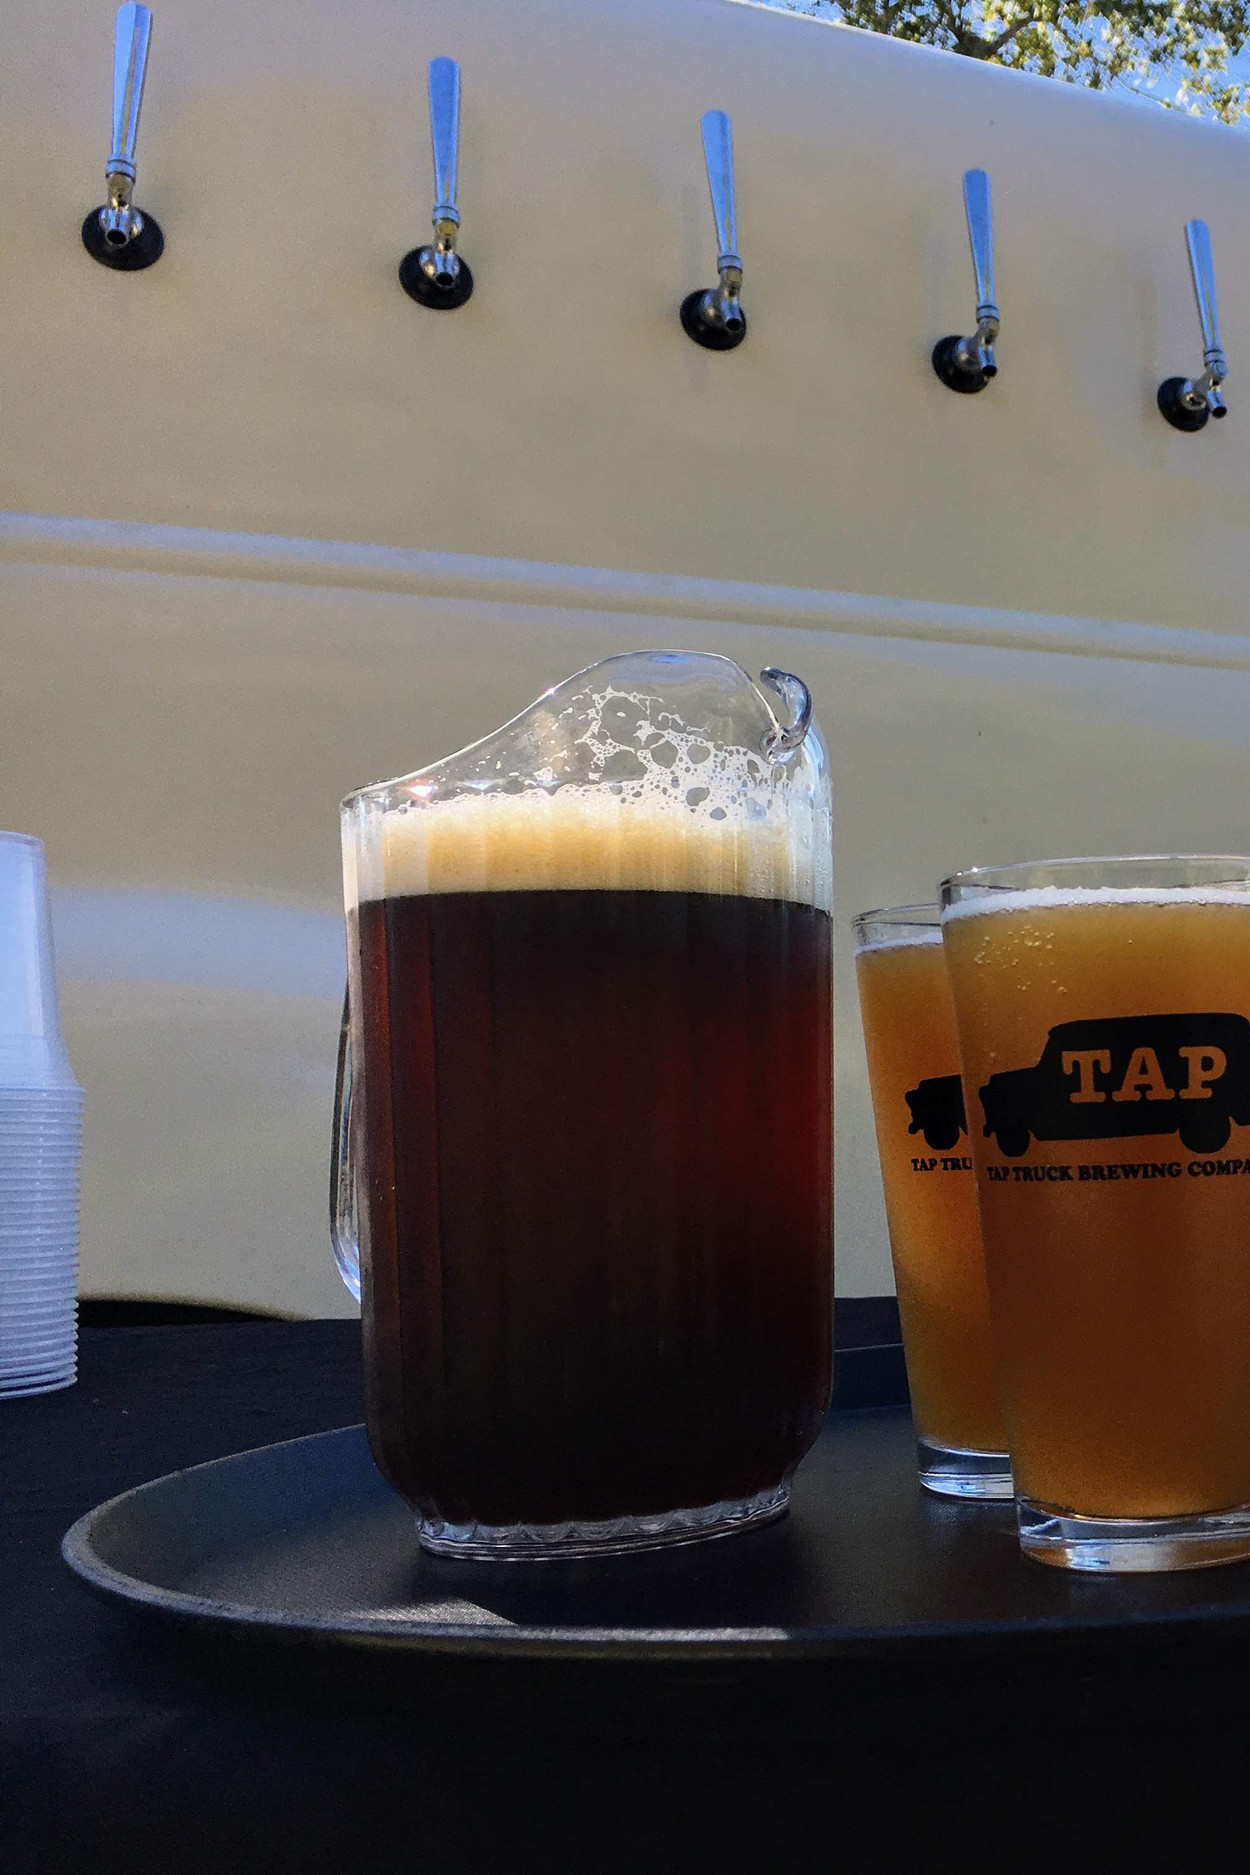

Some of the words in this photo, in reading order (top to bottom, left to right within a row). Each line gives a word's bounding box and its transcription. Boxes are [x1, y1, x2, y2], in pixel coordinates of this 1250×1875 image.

[1061, 1046, 1227, 1103] TAP
[911, 1158, 938, 1171] TAP
[986, 1166, 1010, 1181] TAP
[1012, 1165, 1074, 1182] TRUCK
[1077, 1162, 1183, 1181] BREWING
